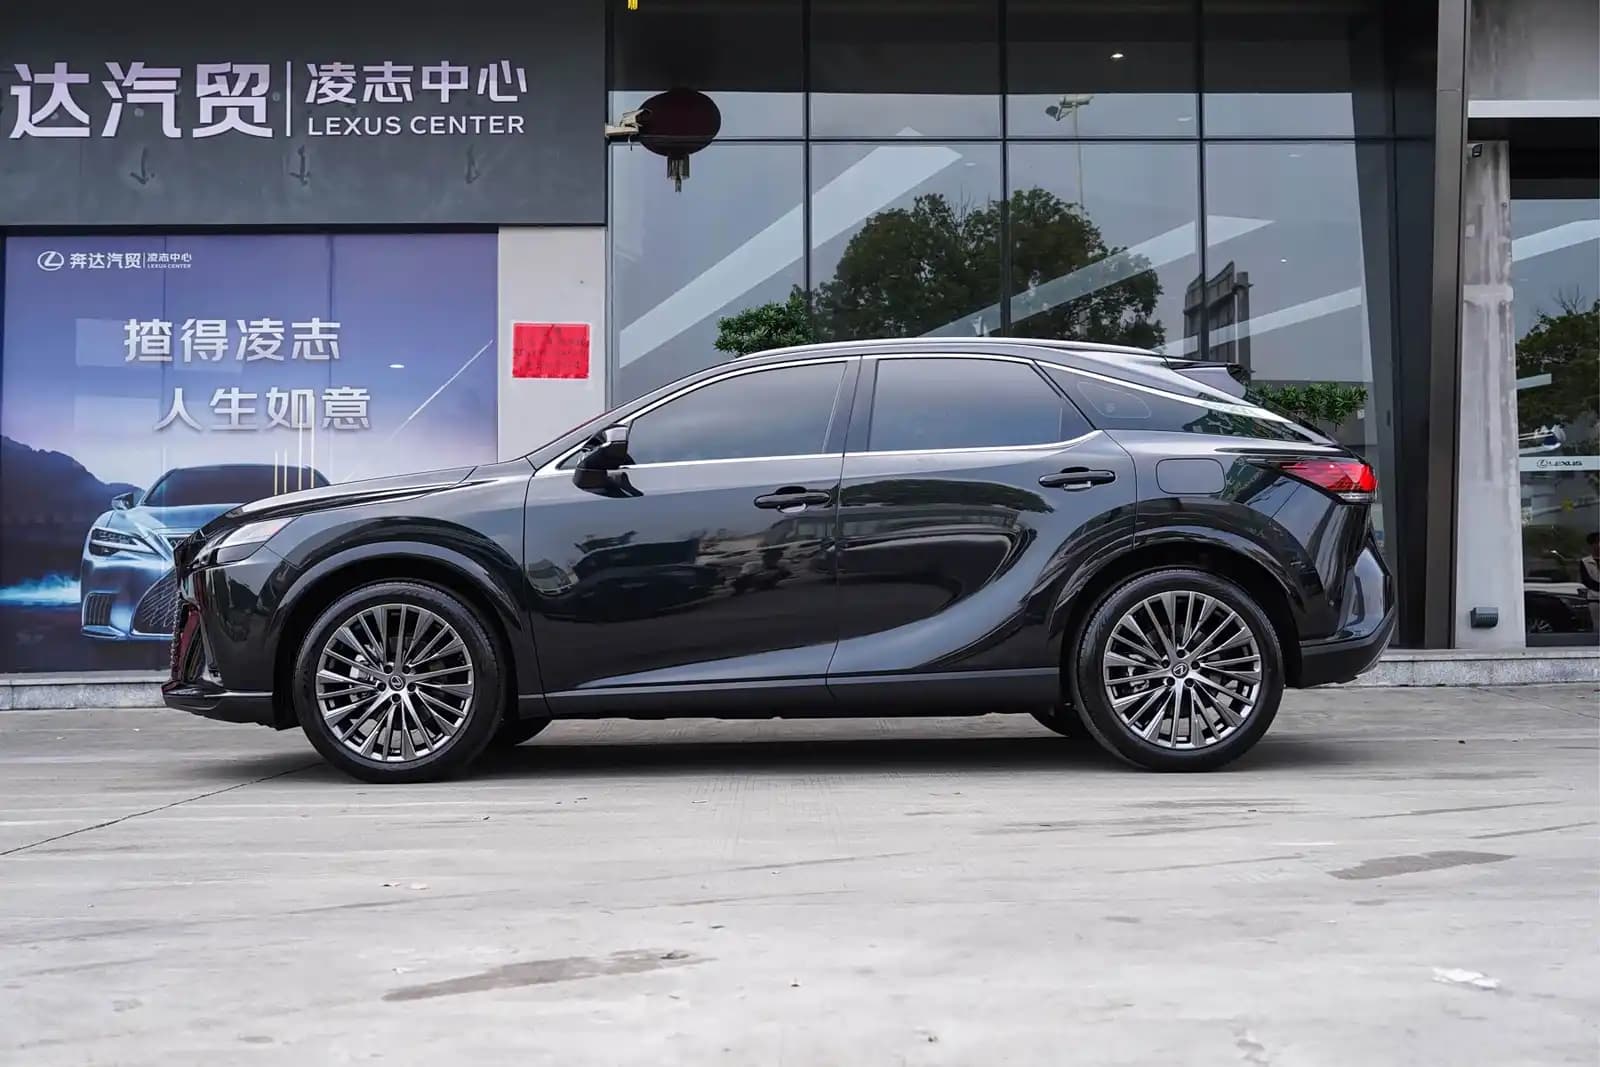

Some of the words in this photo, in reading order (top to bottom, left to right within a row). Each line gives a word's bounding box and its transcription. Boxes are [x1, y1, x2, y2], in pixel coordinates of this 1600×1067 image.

[9, 61, 273, 138] 达汽贸
[305, 60, 528, 104] 凌志中心
[308, 116, 401, 136] LEXUS
[409, 115, 525, 135] CENTER
[70, 252, 142, 269] 奔达汽贸
[147, 252, 192, 263] 凌志中心
[124, 317, 341, 362] 揸得凌志
[153, 386, 371, 431] 人生如意
